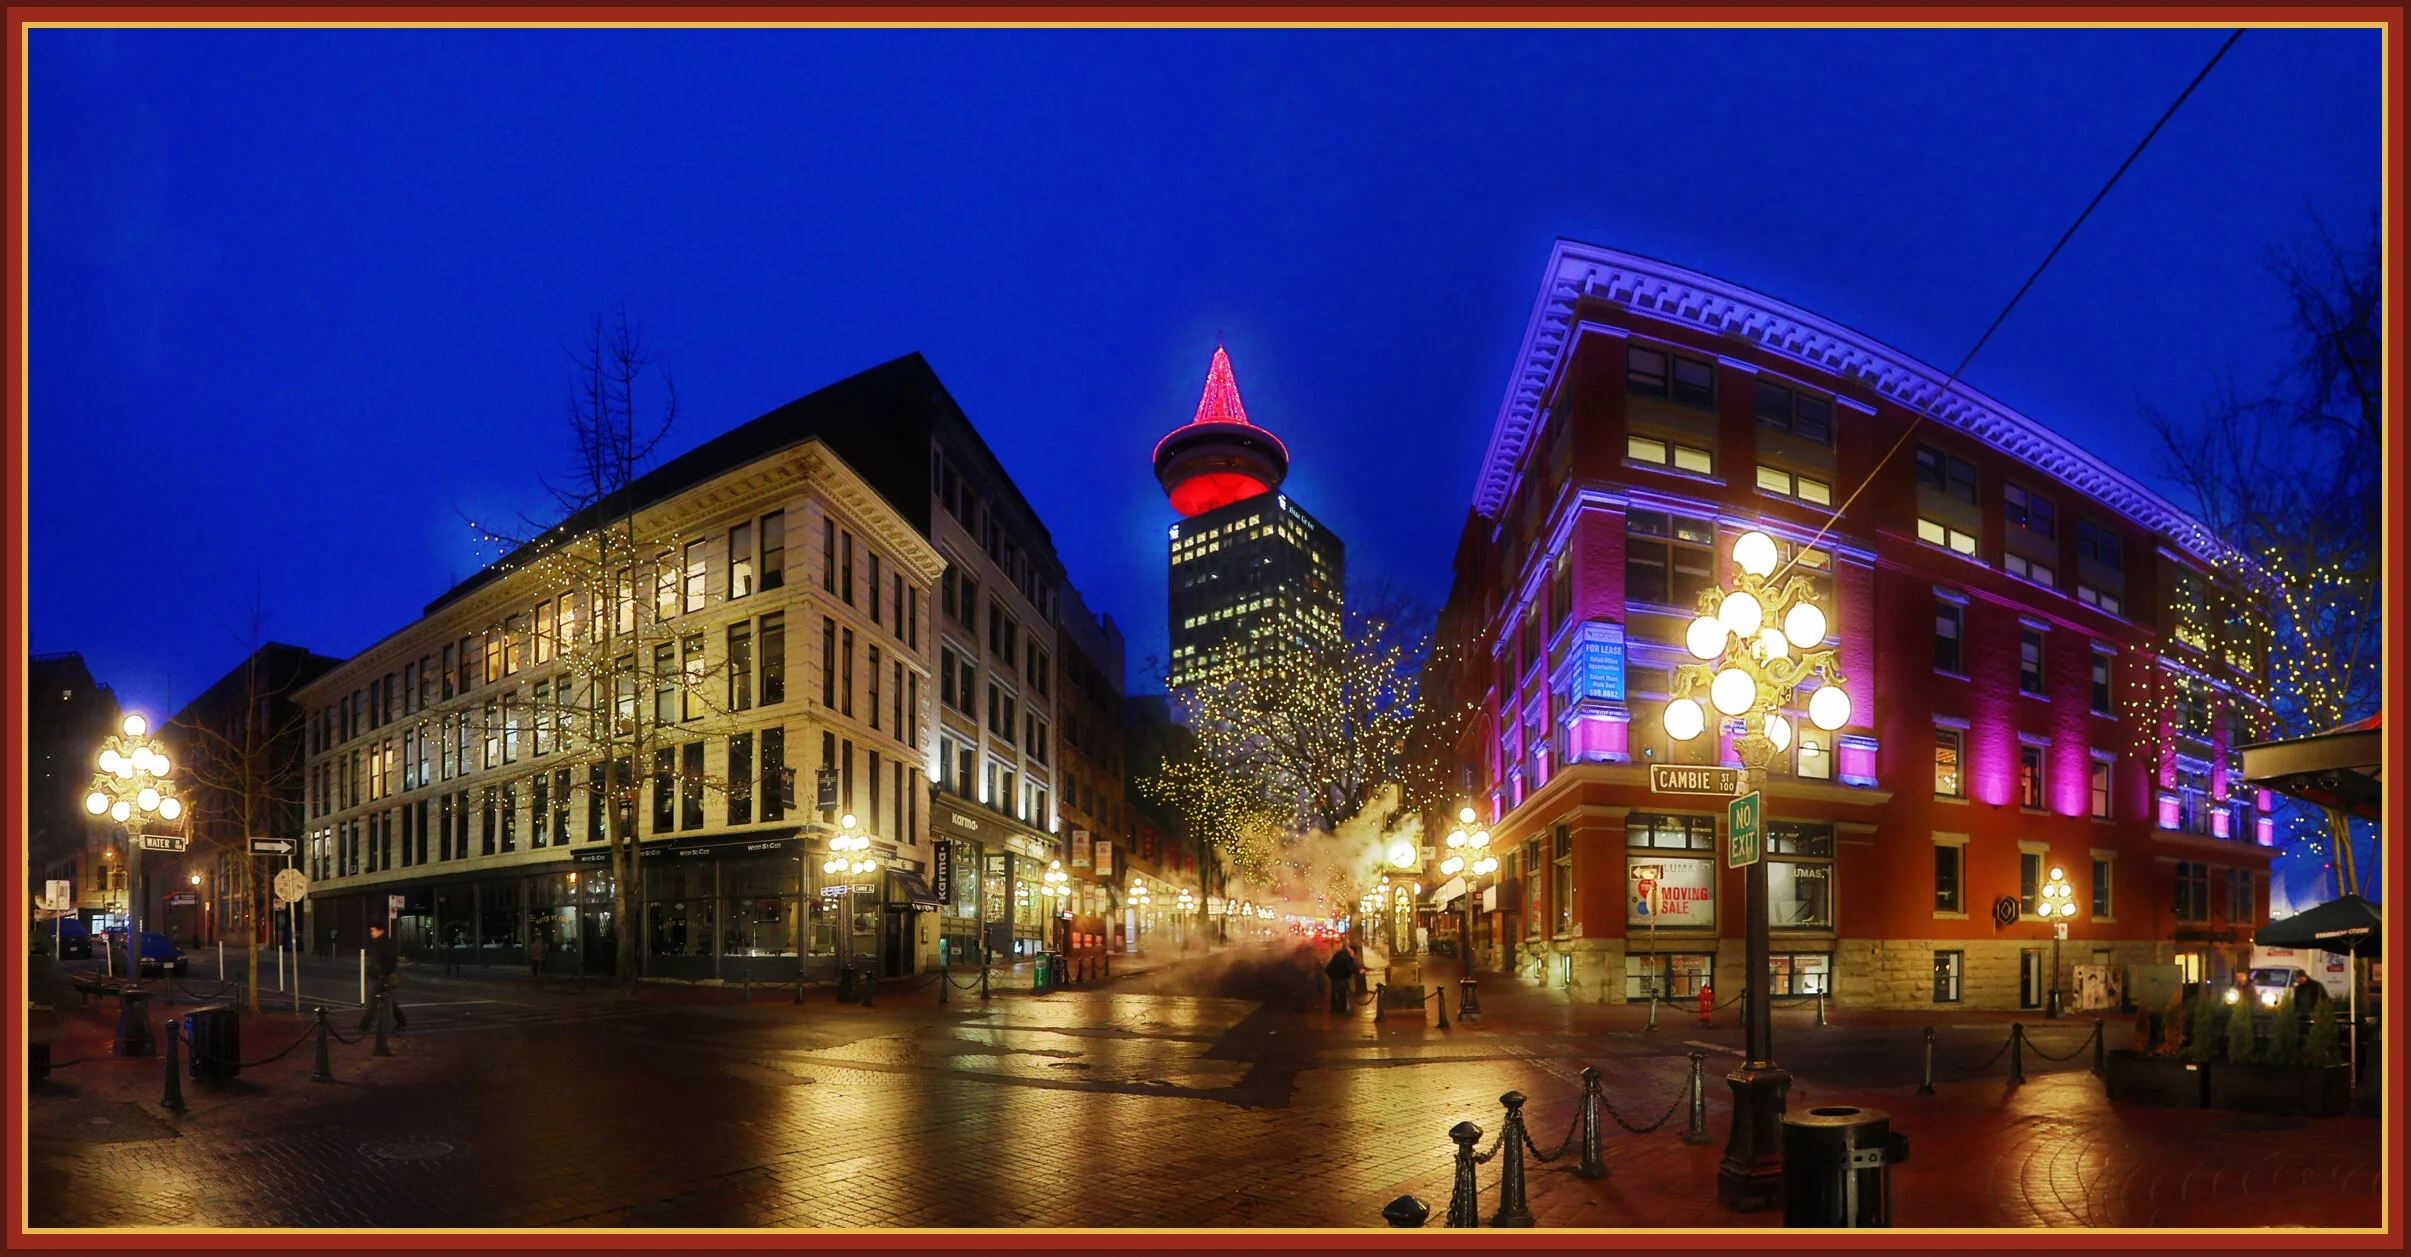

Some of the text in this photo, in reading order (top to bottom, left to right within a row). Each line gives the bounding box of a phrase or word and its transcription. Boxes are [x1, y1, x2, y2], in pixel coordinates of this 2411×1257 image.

[1586, 643, 1622, 655] FOR LEASE
[1660, 771, 1730, 789] CAMBIE ST
[1720, 782, 1734, 791] 100
[1735, 805, 1751, 830] NO
[146, 837, 170, 848] WATER
[1732, 832, 1755, 858] EXIT
[1661, 887, 1709, 900] MOVING
[1661, 901, 1689, 914] SALE
